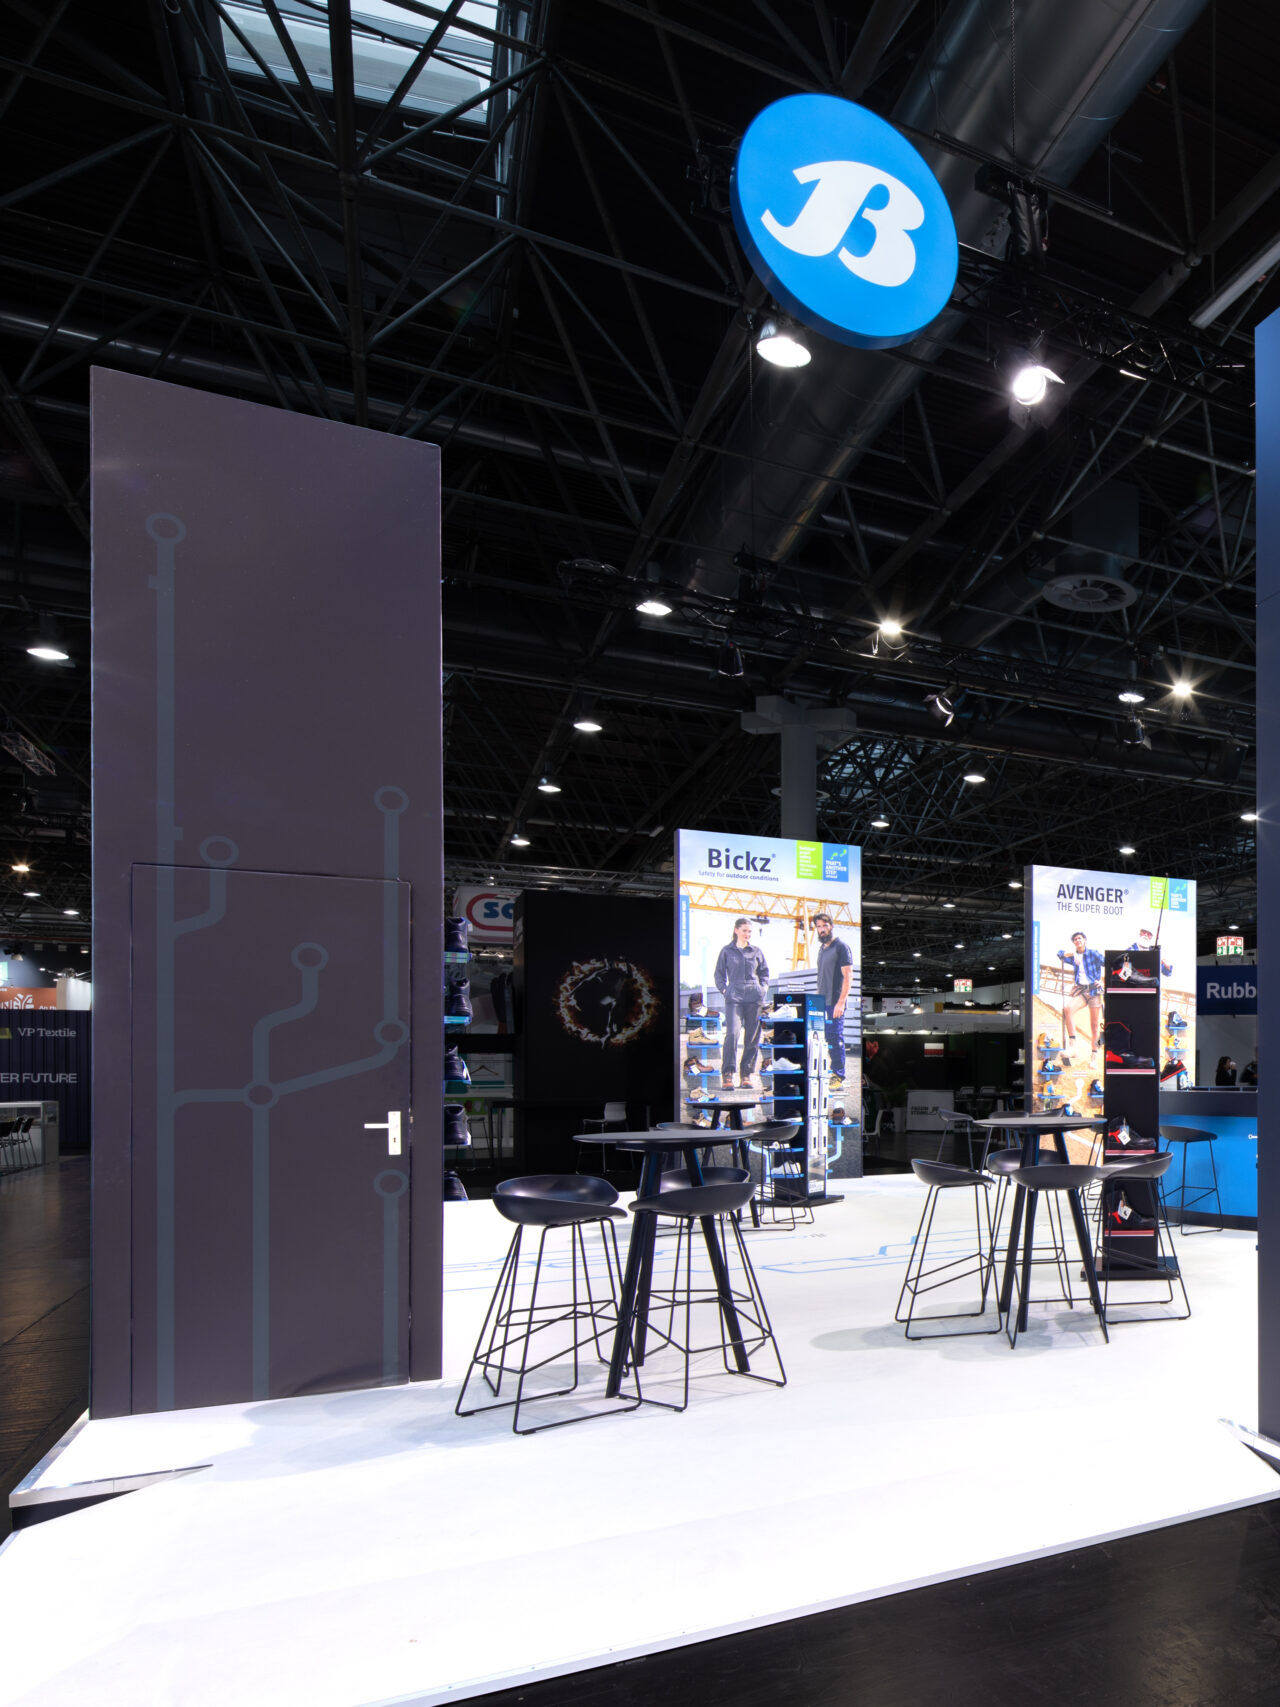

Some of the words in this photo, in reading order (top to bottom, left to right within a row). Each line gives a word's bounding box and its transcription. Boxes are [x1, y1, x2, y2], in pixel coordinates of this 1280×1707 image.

[707, 848, 772, 873] Bickz
[1057, 901, 1072, 912] THE
[1075, 904, 1101, 914] SUPER
[1103, 906, 1124, 916] BOOT
[1206, 982, 1257, 999] Rubb
[18, 1027, 35, 1037] VP
[37, 1027, 77, 1037] Textile
[22, 1072, 78, 1084] FUTURE
